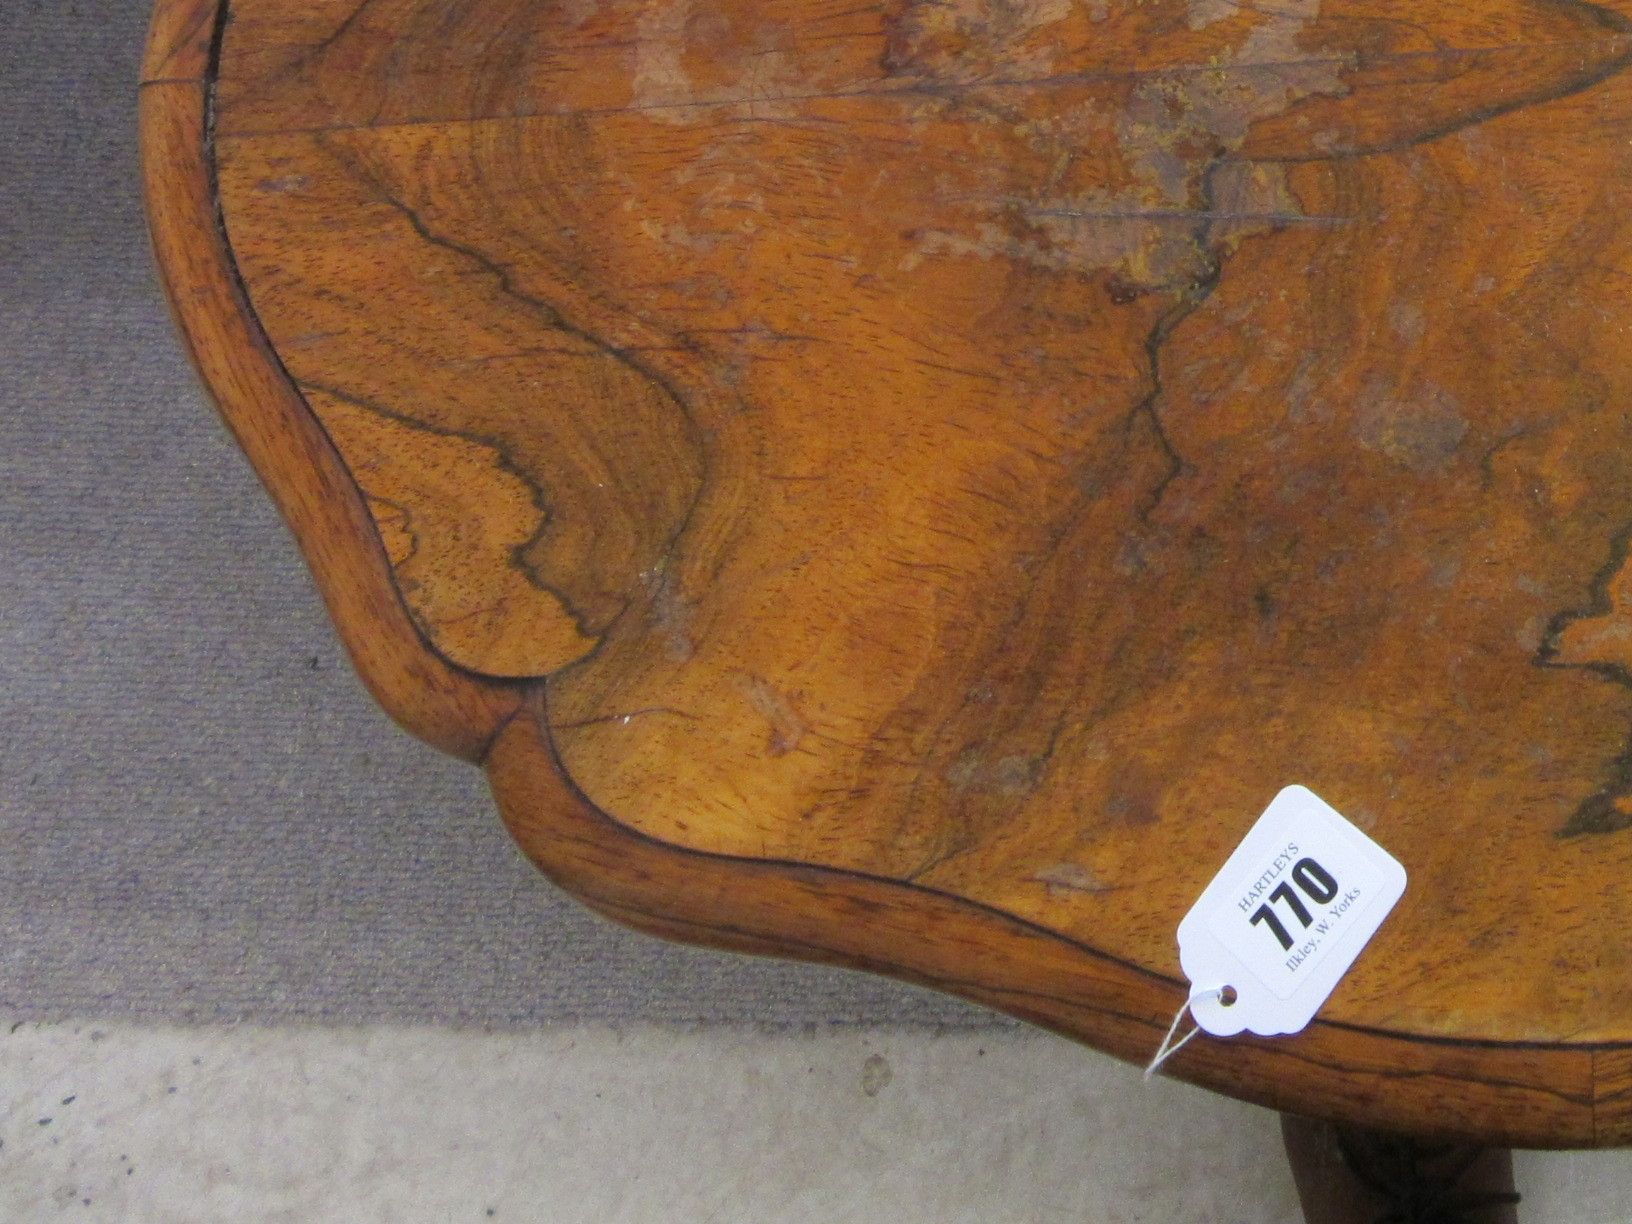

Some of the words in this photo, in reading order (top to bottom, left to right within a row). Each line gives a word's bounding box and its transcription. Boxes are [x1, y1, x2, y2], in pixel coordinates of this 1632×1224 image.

[1238, 842, 1299, 912] HARTLEYS
[1249, 857, 1338, 952] 770
[1285, 936, 1321, 972] Ilkley,
[1316, 919, 1334, 936] W.
[1329, 887, 1361, 920] Yorks
